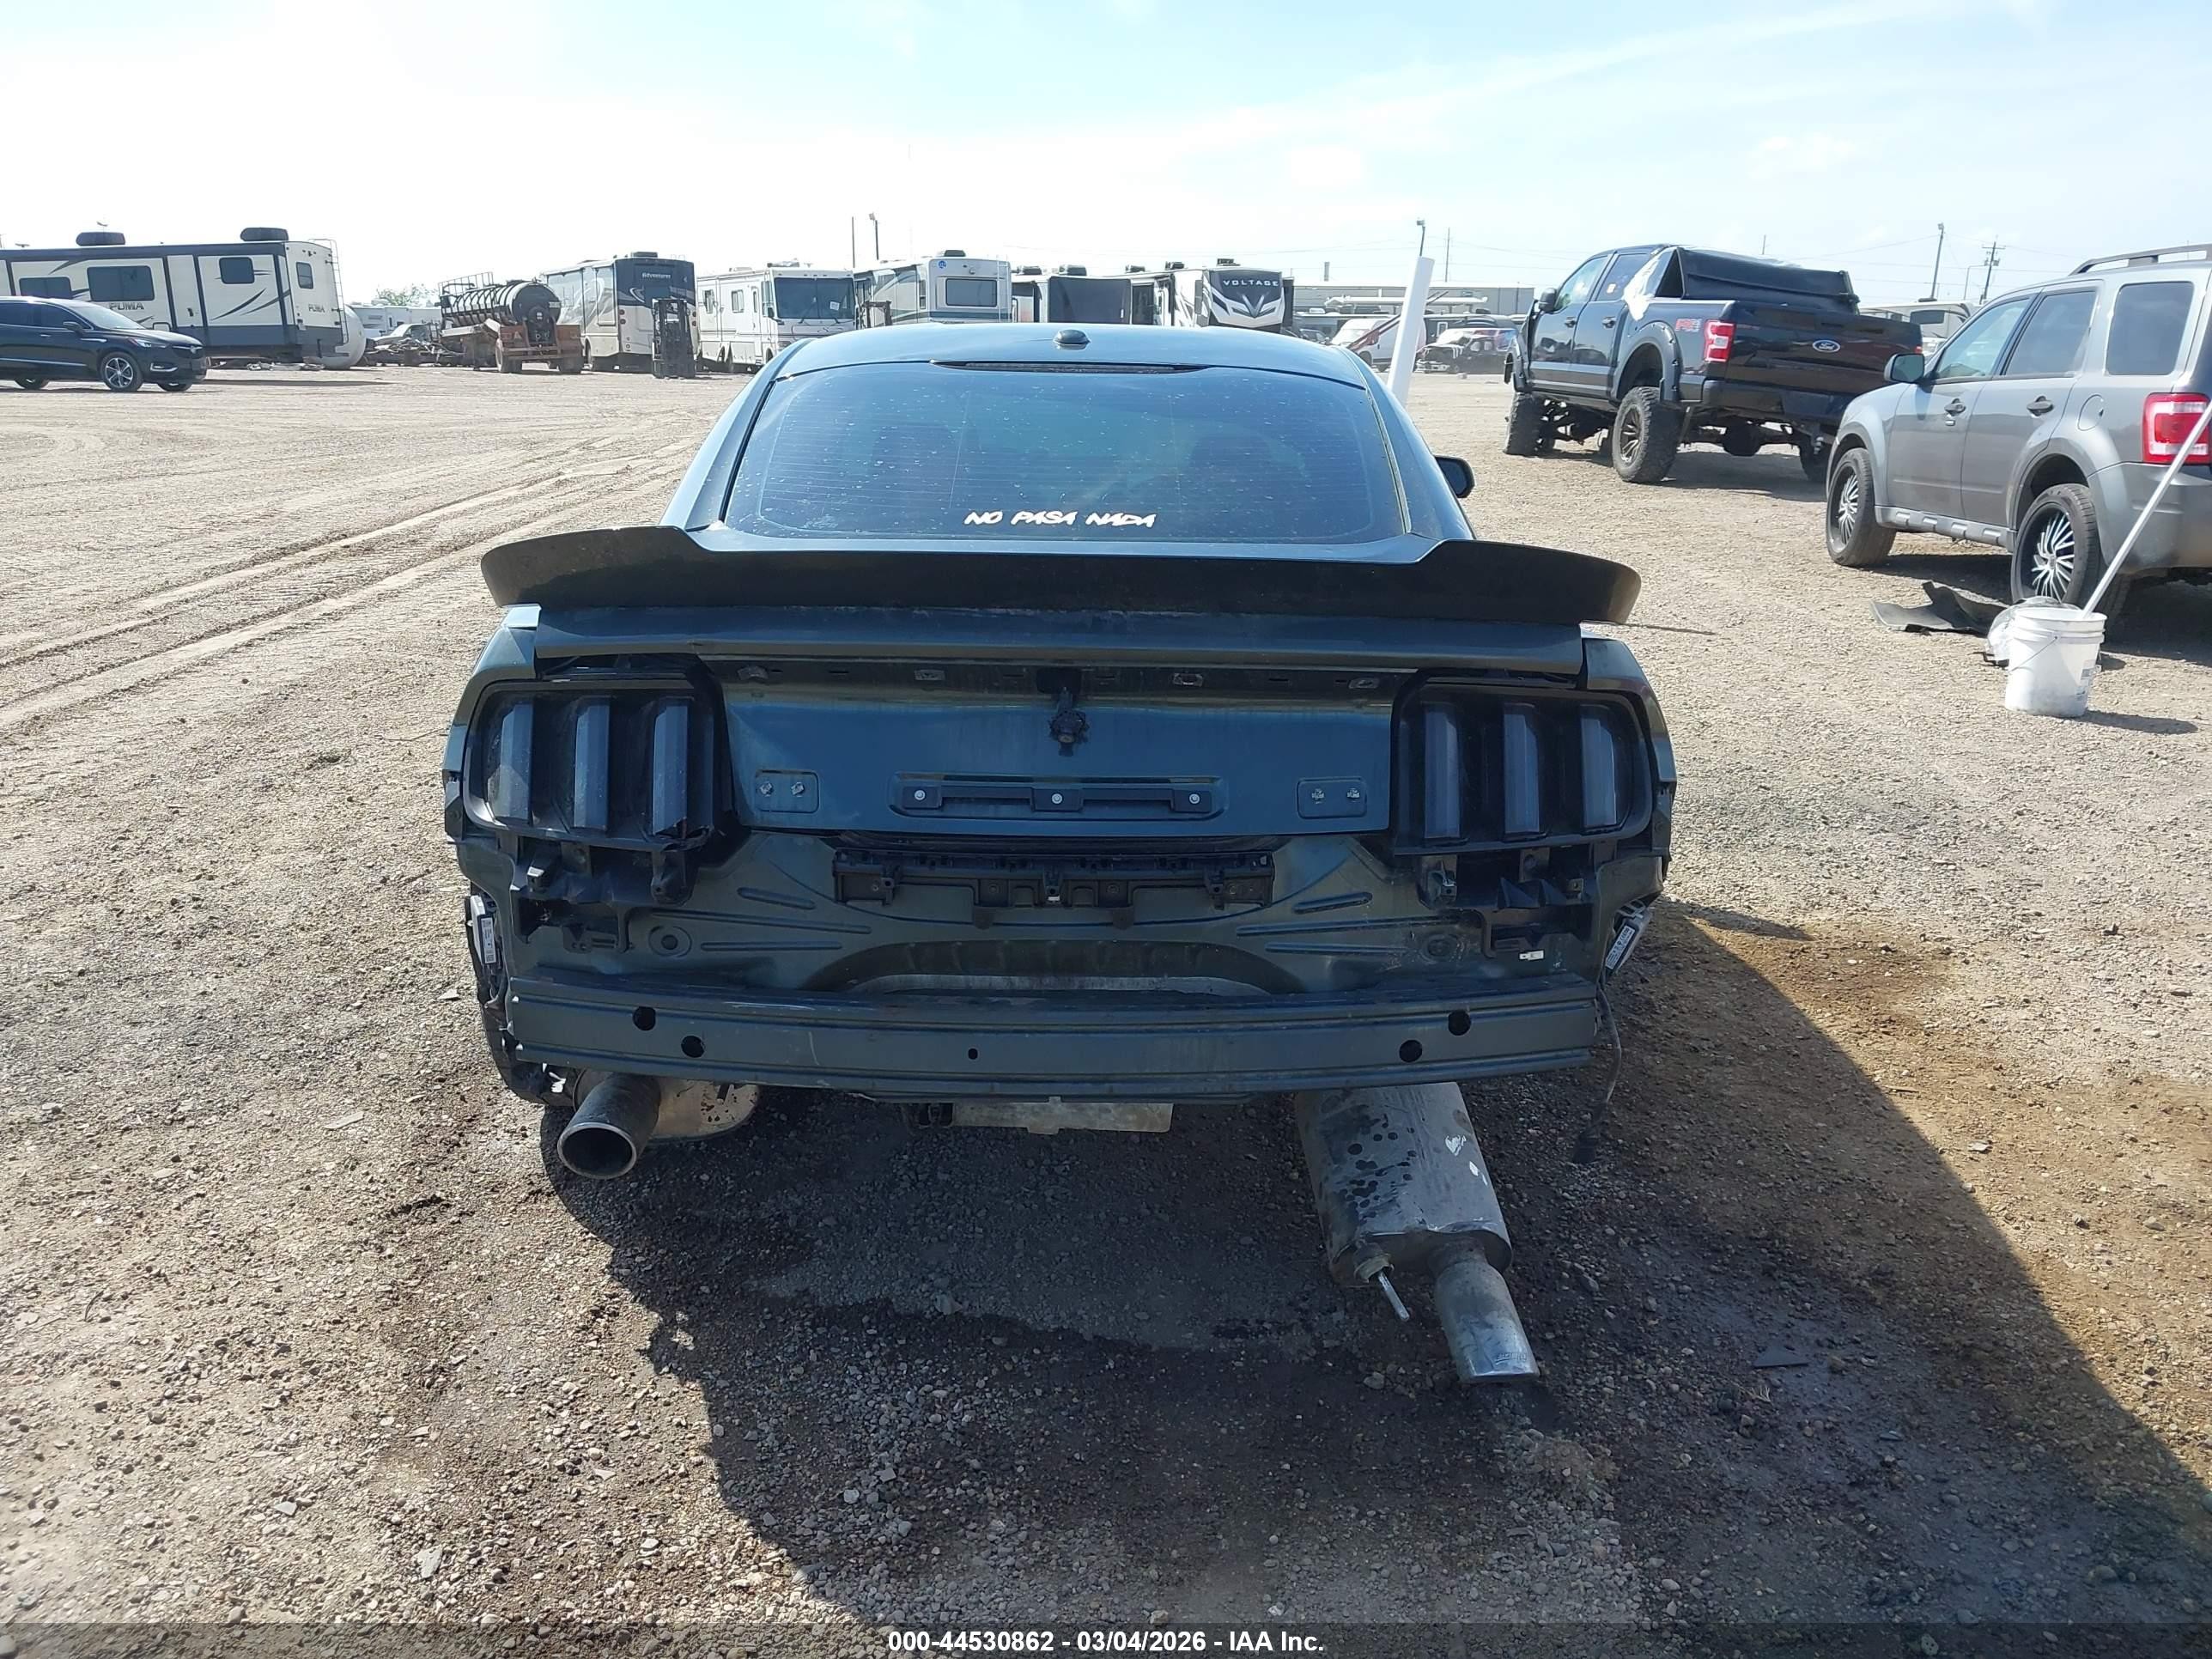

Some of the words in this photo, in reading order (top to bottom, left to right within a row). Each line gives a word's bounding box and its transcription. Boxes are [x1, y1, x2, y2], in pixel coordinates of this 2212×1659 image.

[109, 301, 145, 311] PUMA
[963, 511, 1003, 525] NO
[1010, 510, 1079, 525] PASA
[1085, 513, 1157, 527] NADA
